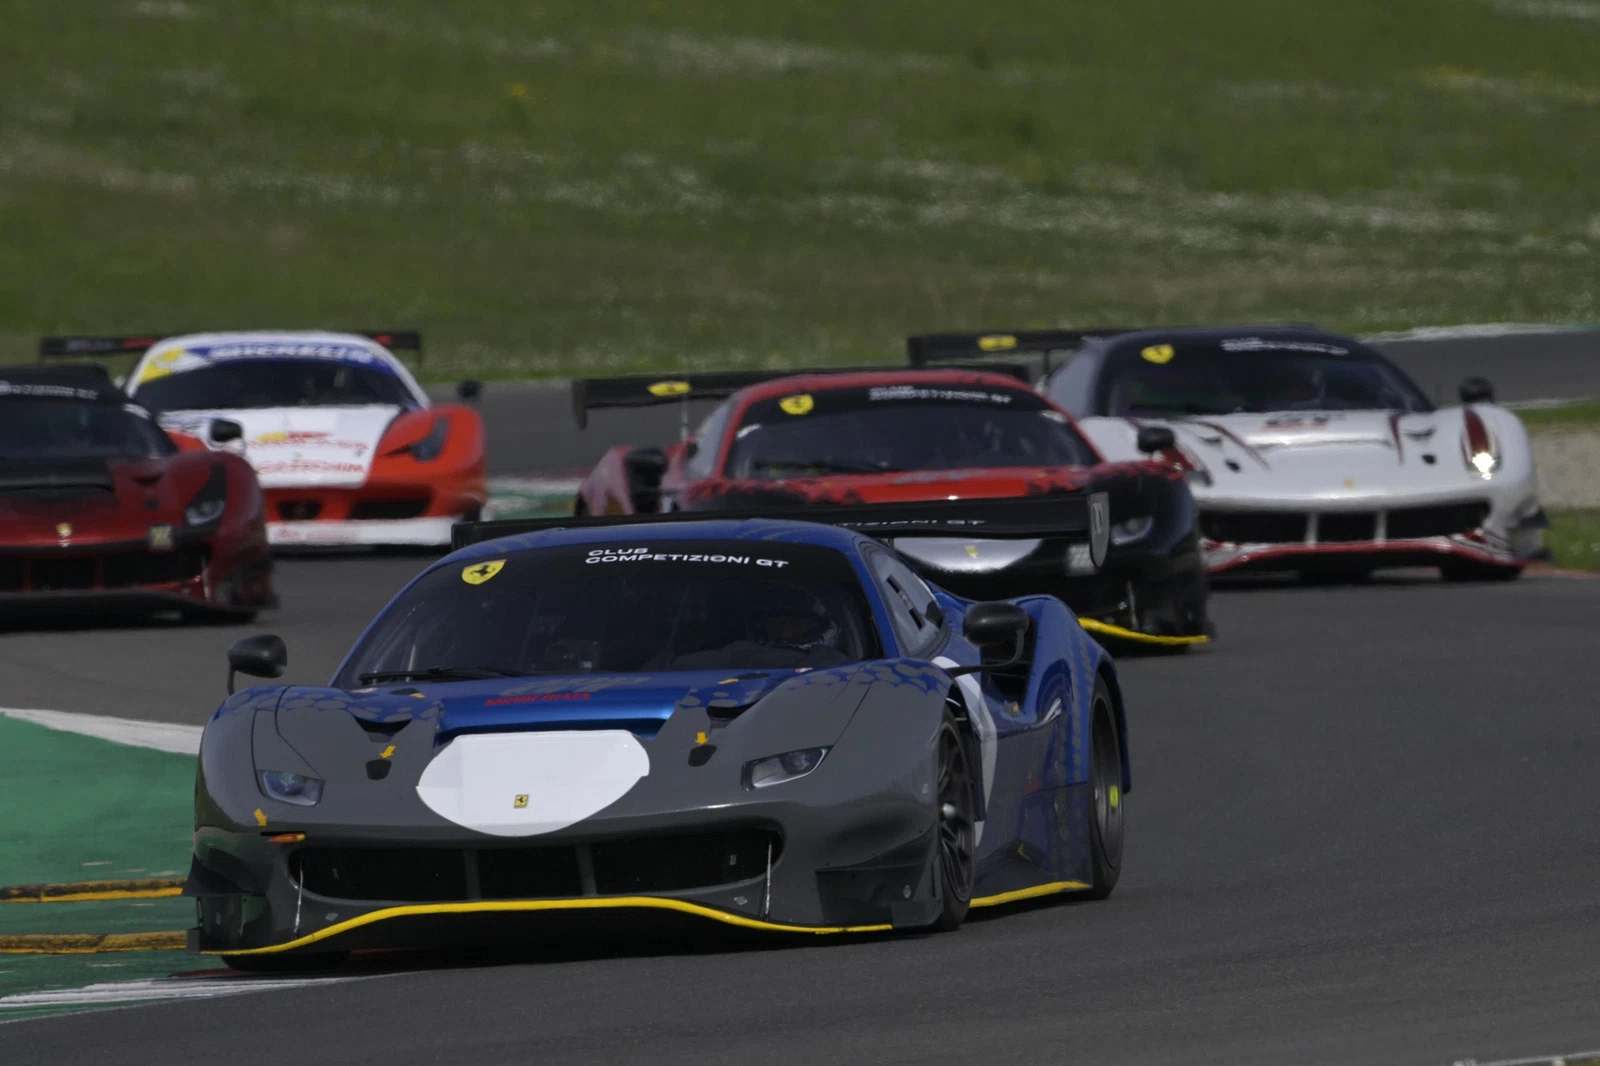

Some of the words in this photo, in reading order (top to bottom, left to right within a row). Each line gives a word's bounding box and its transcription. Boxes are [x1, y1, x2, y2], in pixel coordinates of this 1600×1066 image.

[587, 547, 649, 557] CLUB
[585, 553, 750, 565] COMPETIZIONI
[755, 557, 789, 568] GT
